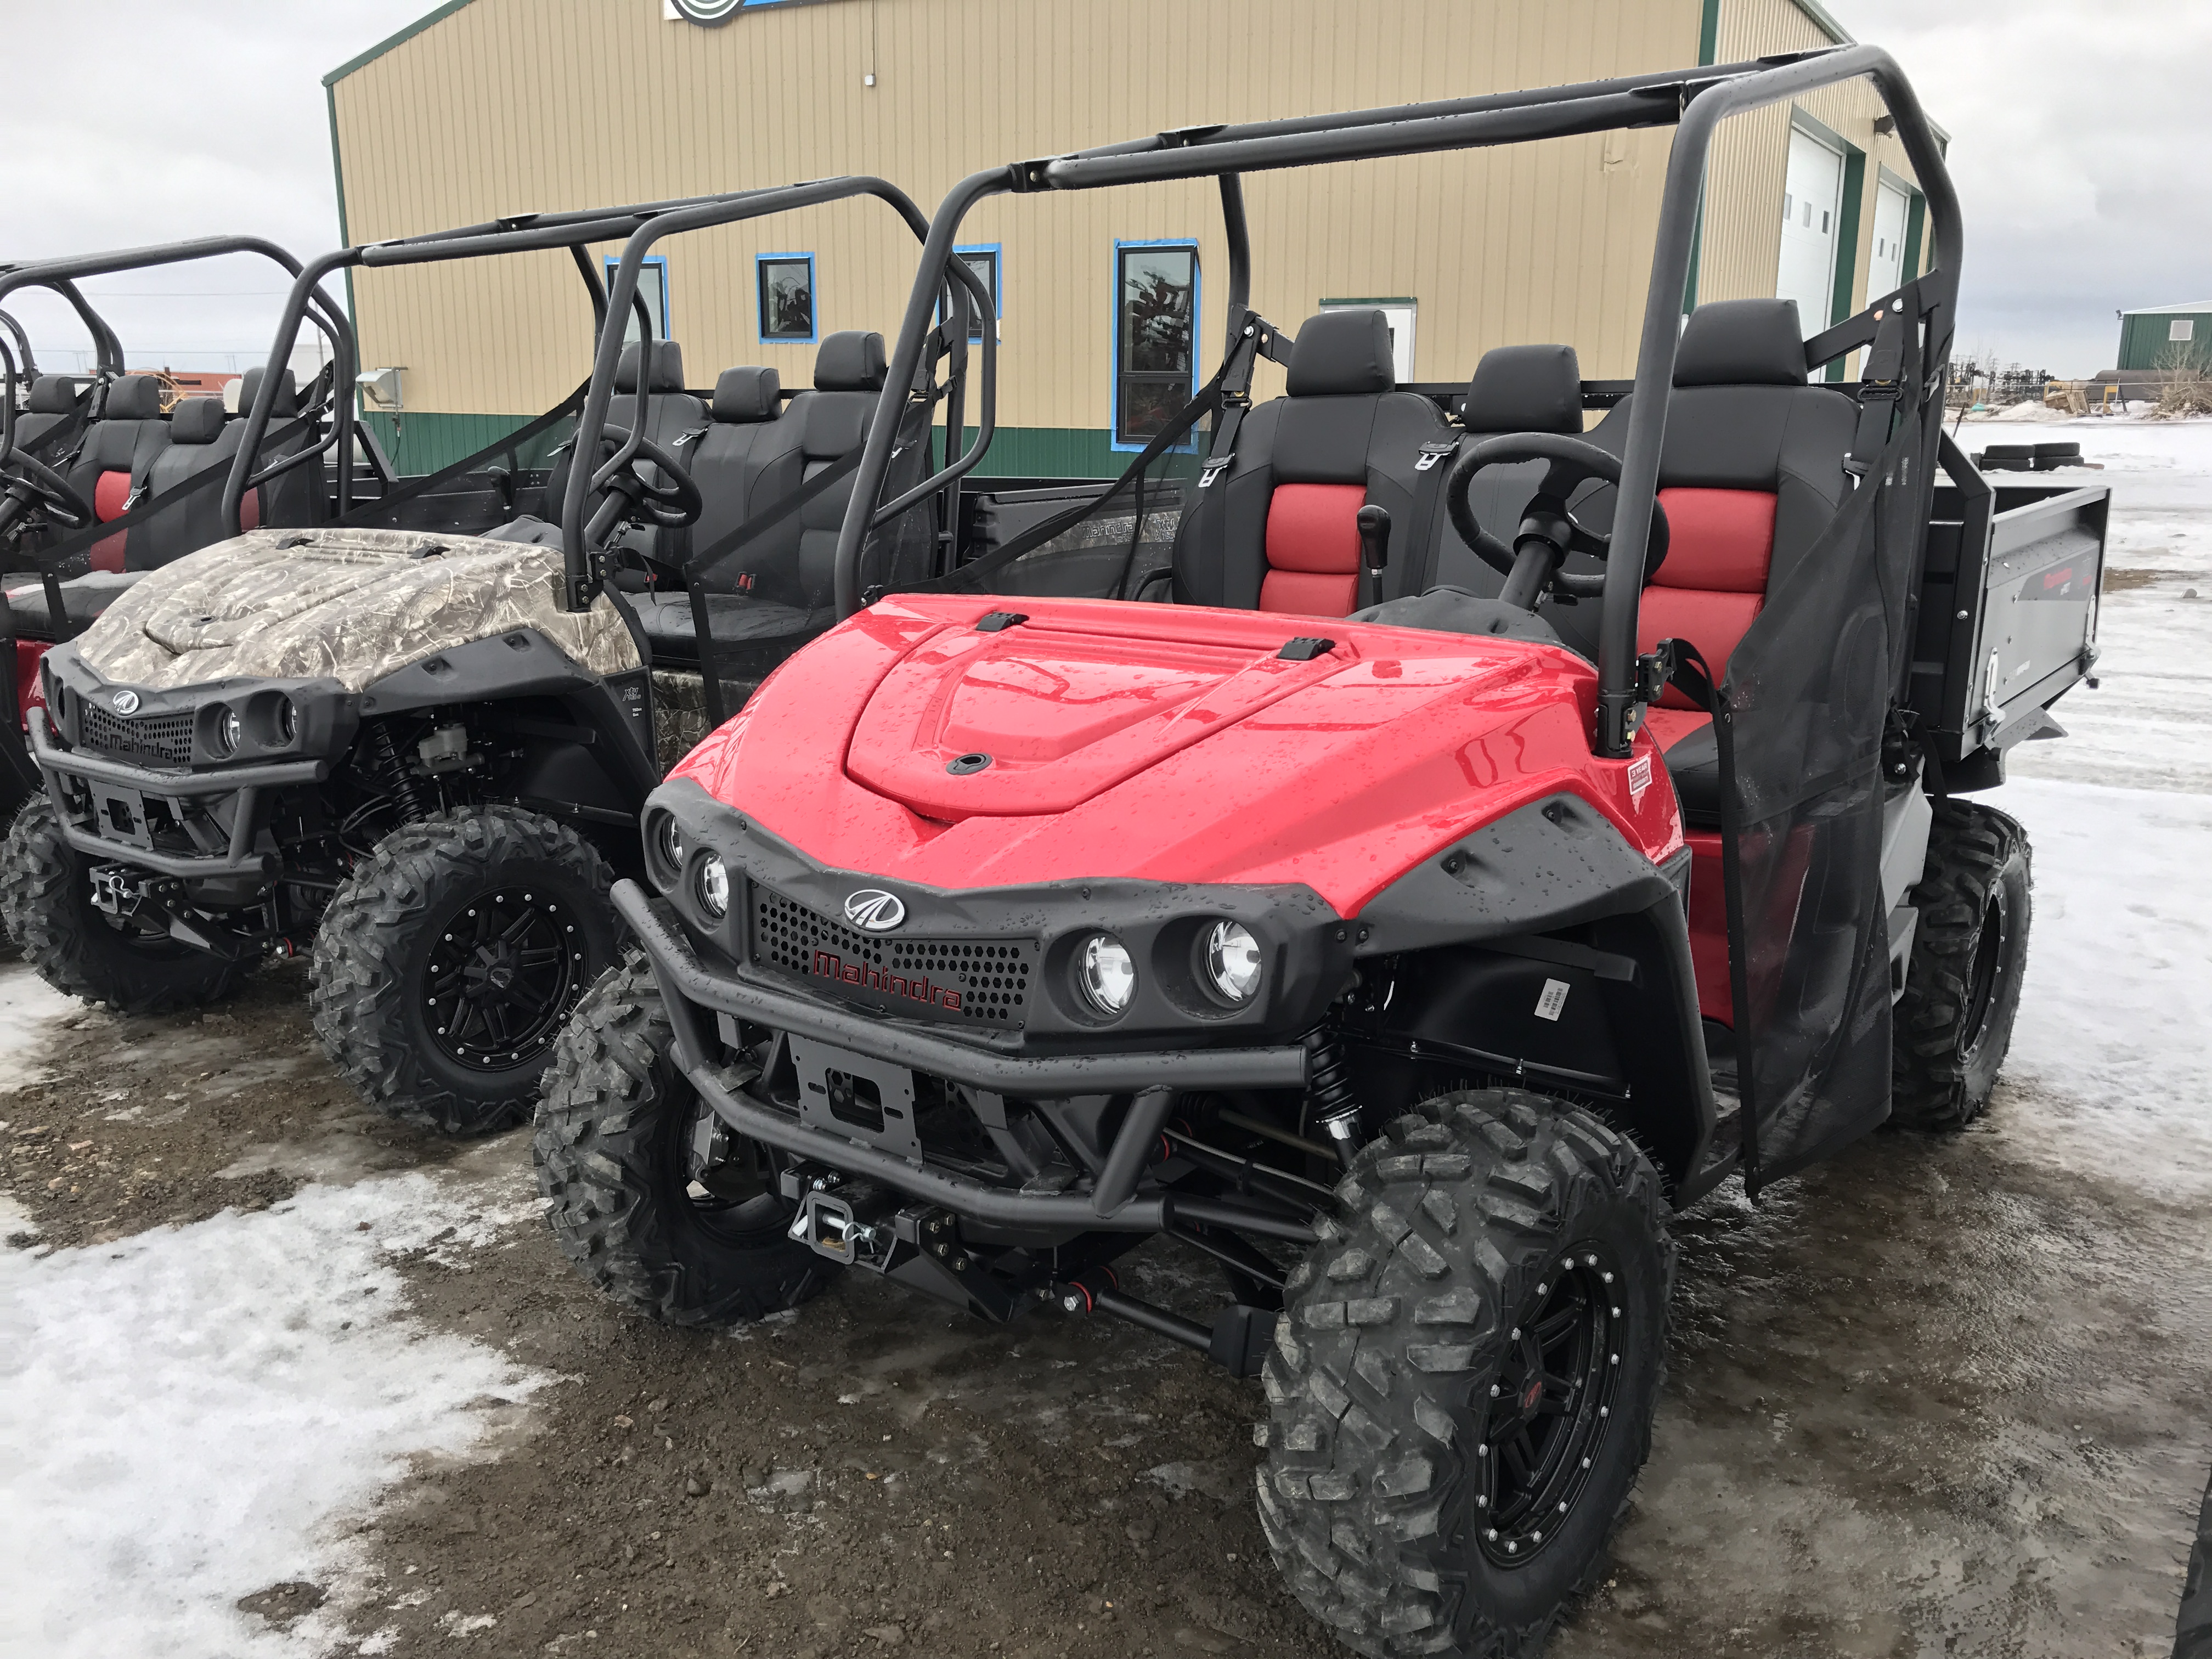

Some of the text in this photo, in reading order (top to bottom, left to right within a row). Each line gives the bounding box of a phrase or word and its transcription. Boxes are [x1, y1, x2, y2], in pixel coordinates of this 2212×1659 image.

[110, 733, 173, 760] Mahindra
[1636, 763, 1647, 775] YEAR
[813, 950, 962, 1012] Mahindra
